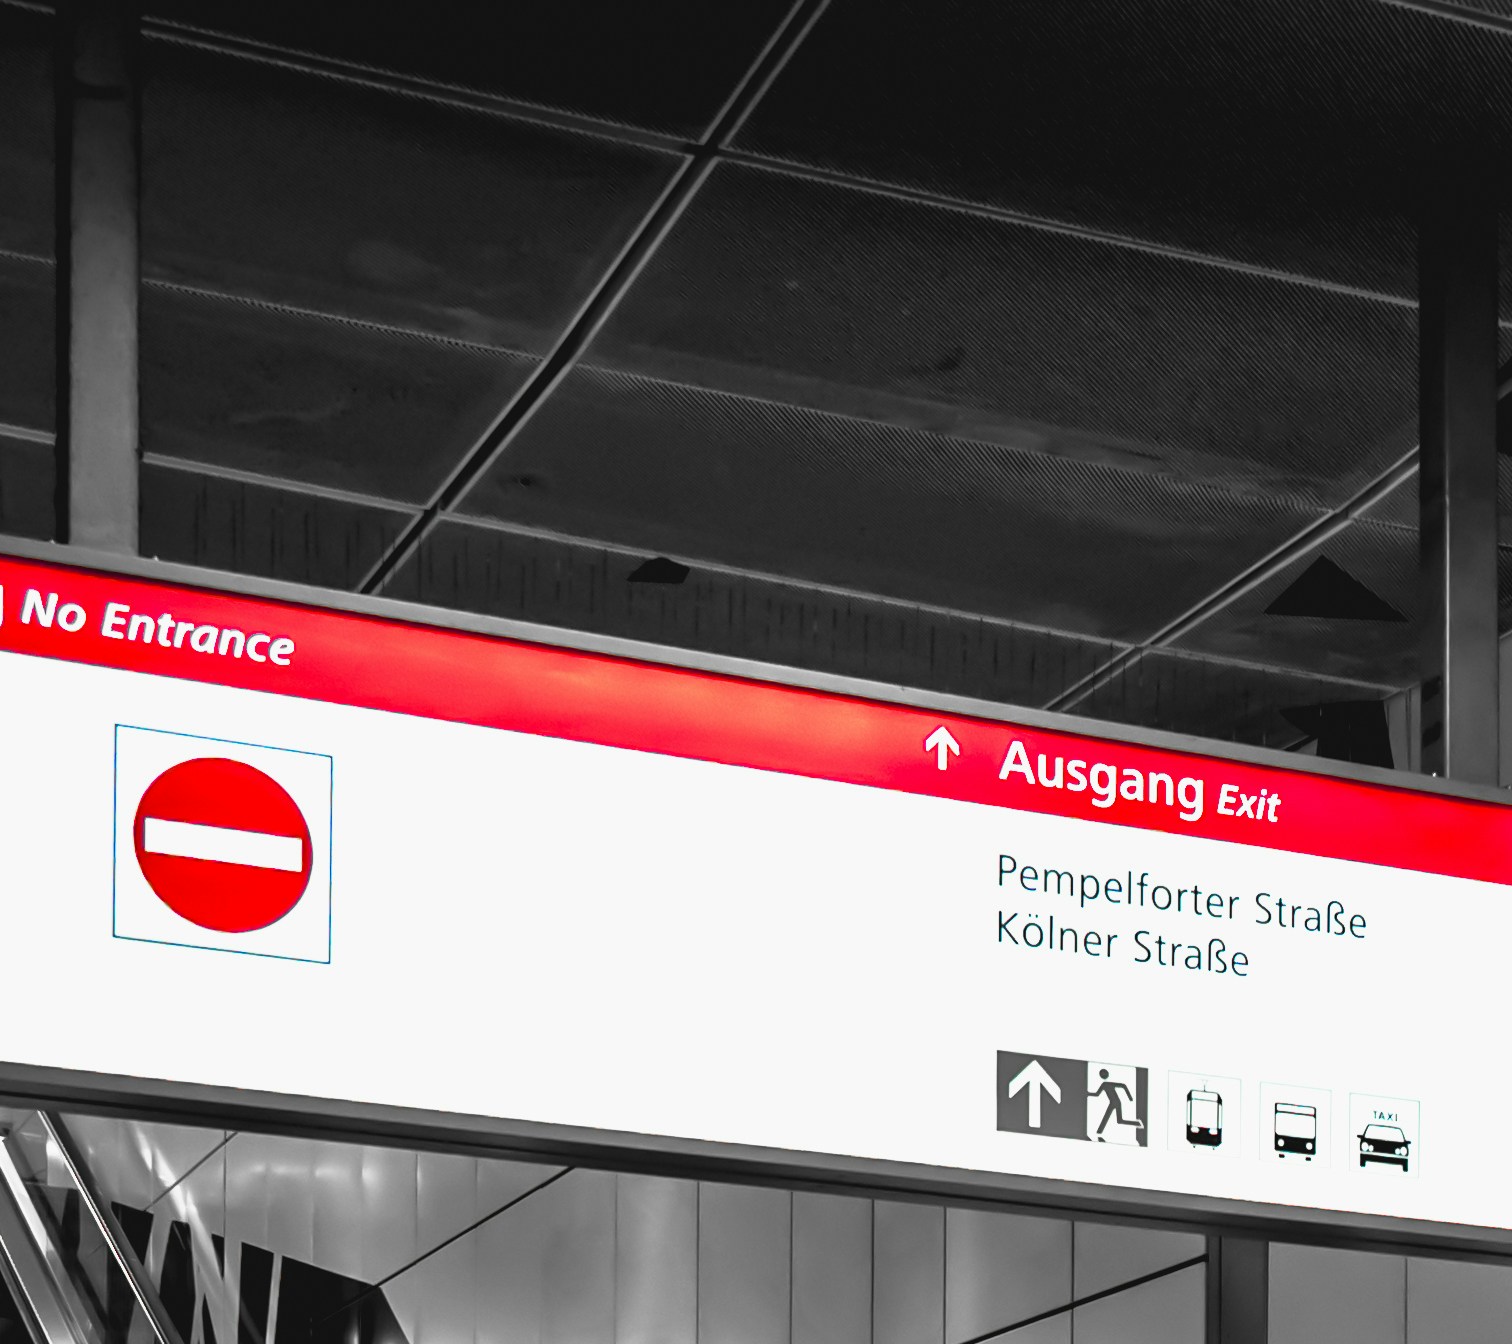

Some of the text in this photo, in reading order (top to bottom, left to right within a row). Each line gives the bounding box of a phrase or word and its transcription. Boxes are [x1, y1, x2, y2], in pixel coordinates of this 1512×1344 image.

[20, 588, 87, 633] No
[101, 602, 296, 667] Entrance
[998, 740, 1282, 823] Ausgang Exit
[998, 854, 1368, 939] Pempelforter Straße
[998, 910, 1250, 977] Kölner Straße
[1373, 1110, 1398, 1122] TAXI
